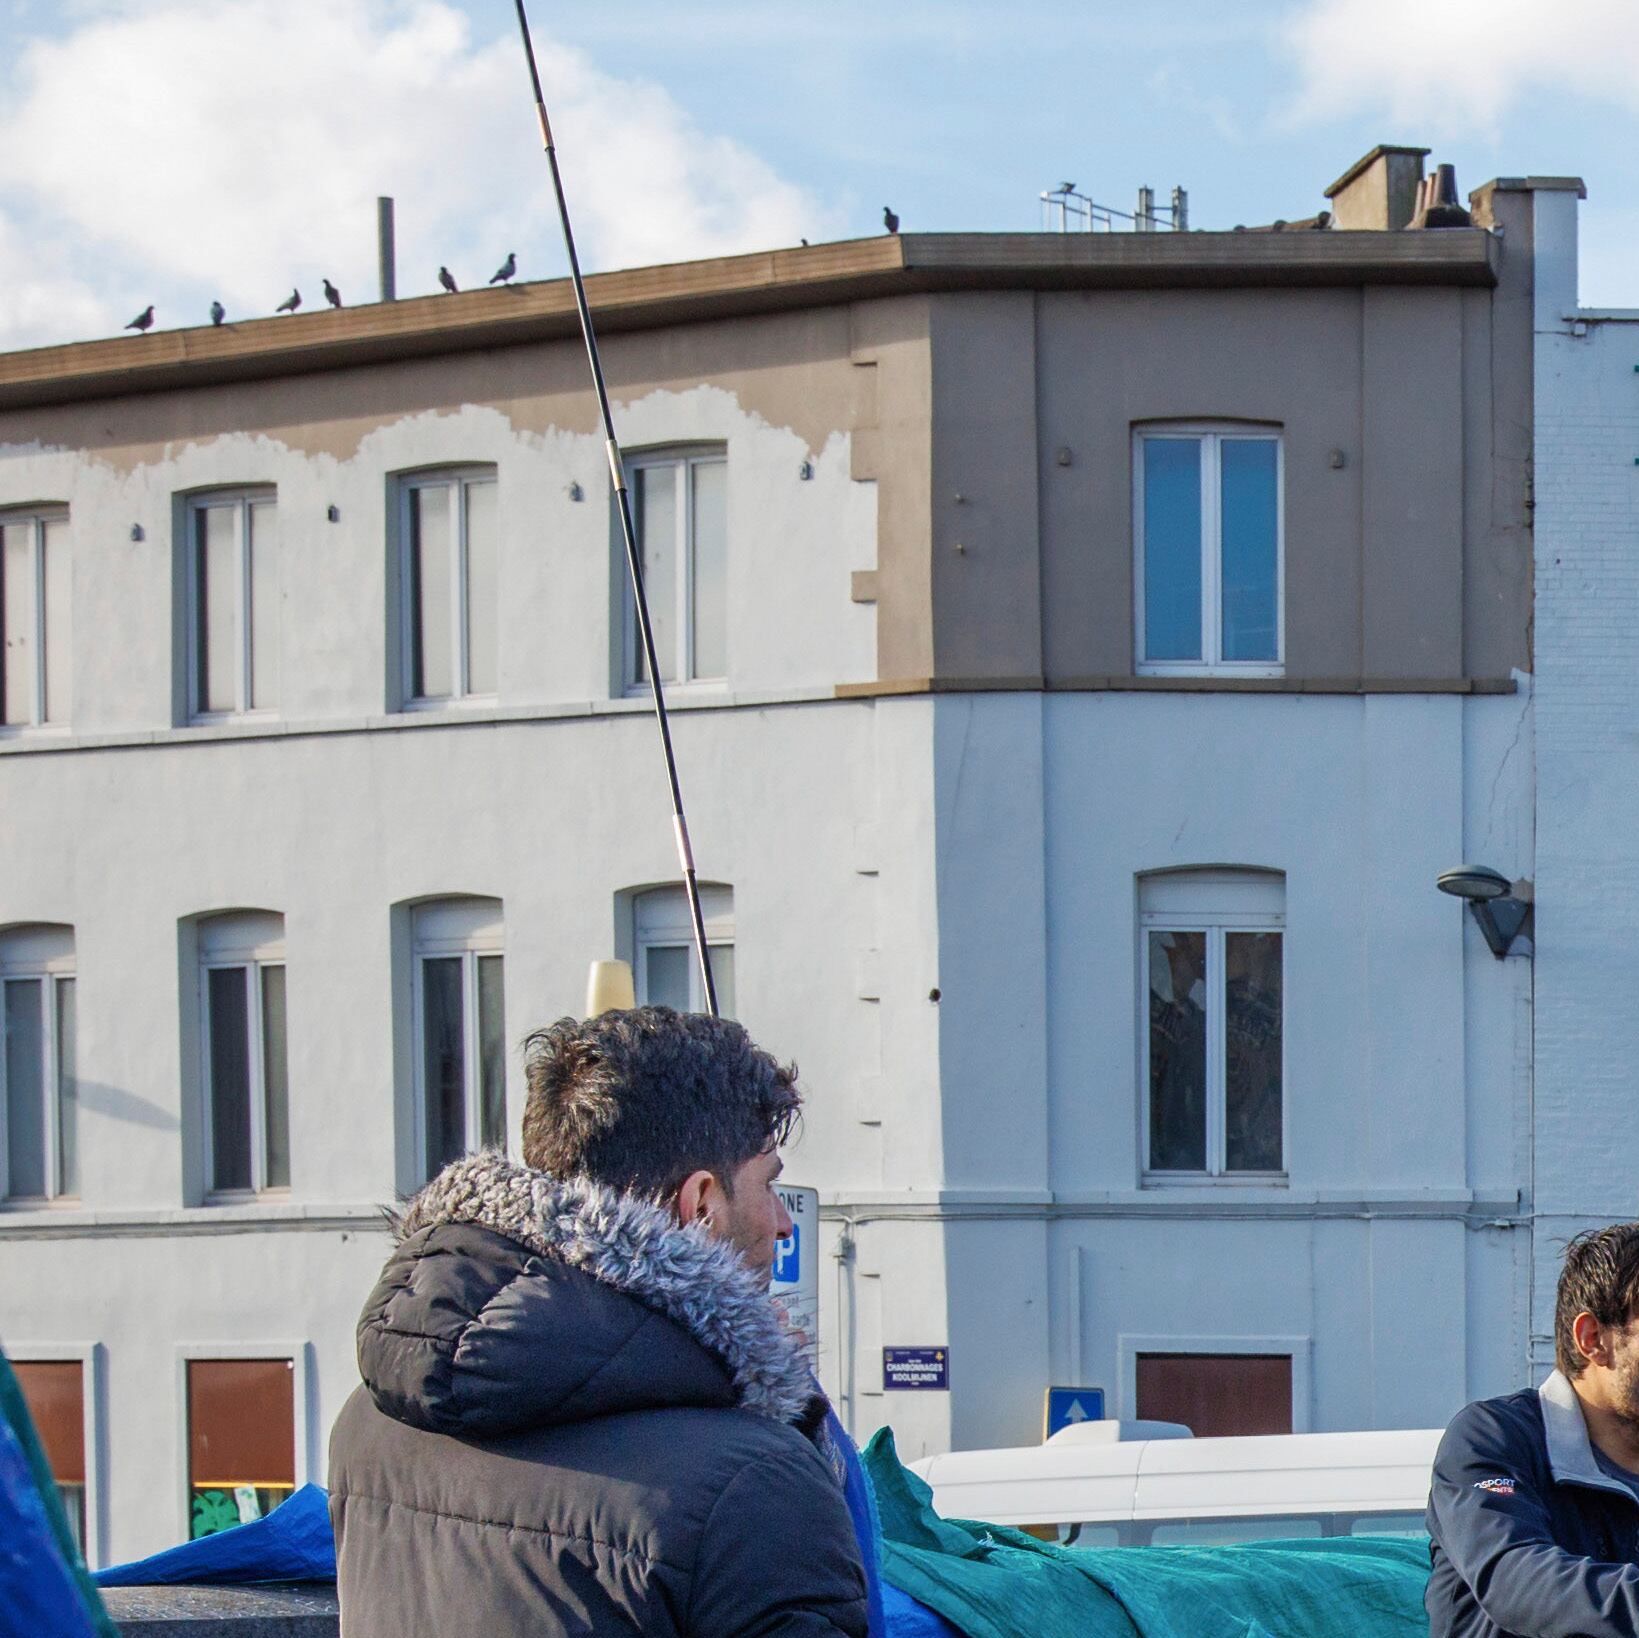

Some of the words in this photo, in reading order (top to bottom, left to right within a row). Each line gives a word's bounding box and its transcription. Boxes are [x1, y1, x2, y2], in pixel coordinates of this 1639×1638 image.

[779, 1192, 804, 1214] ONE
[777, 1234, 795, 1275] P
[886, 1363, 944, 1372] CHARBONNAGES
